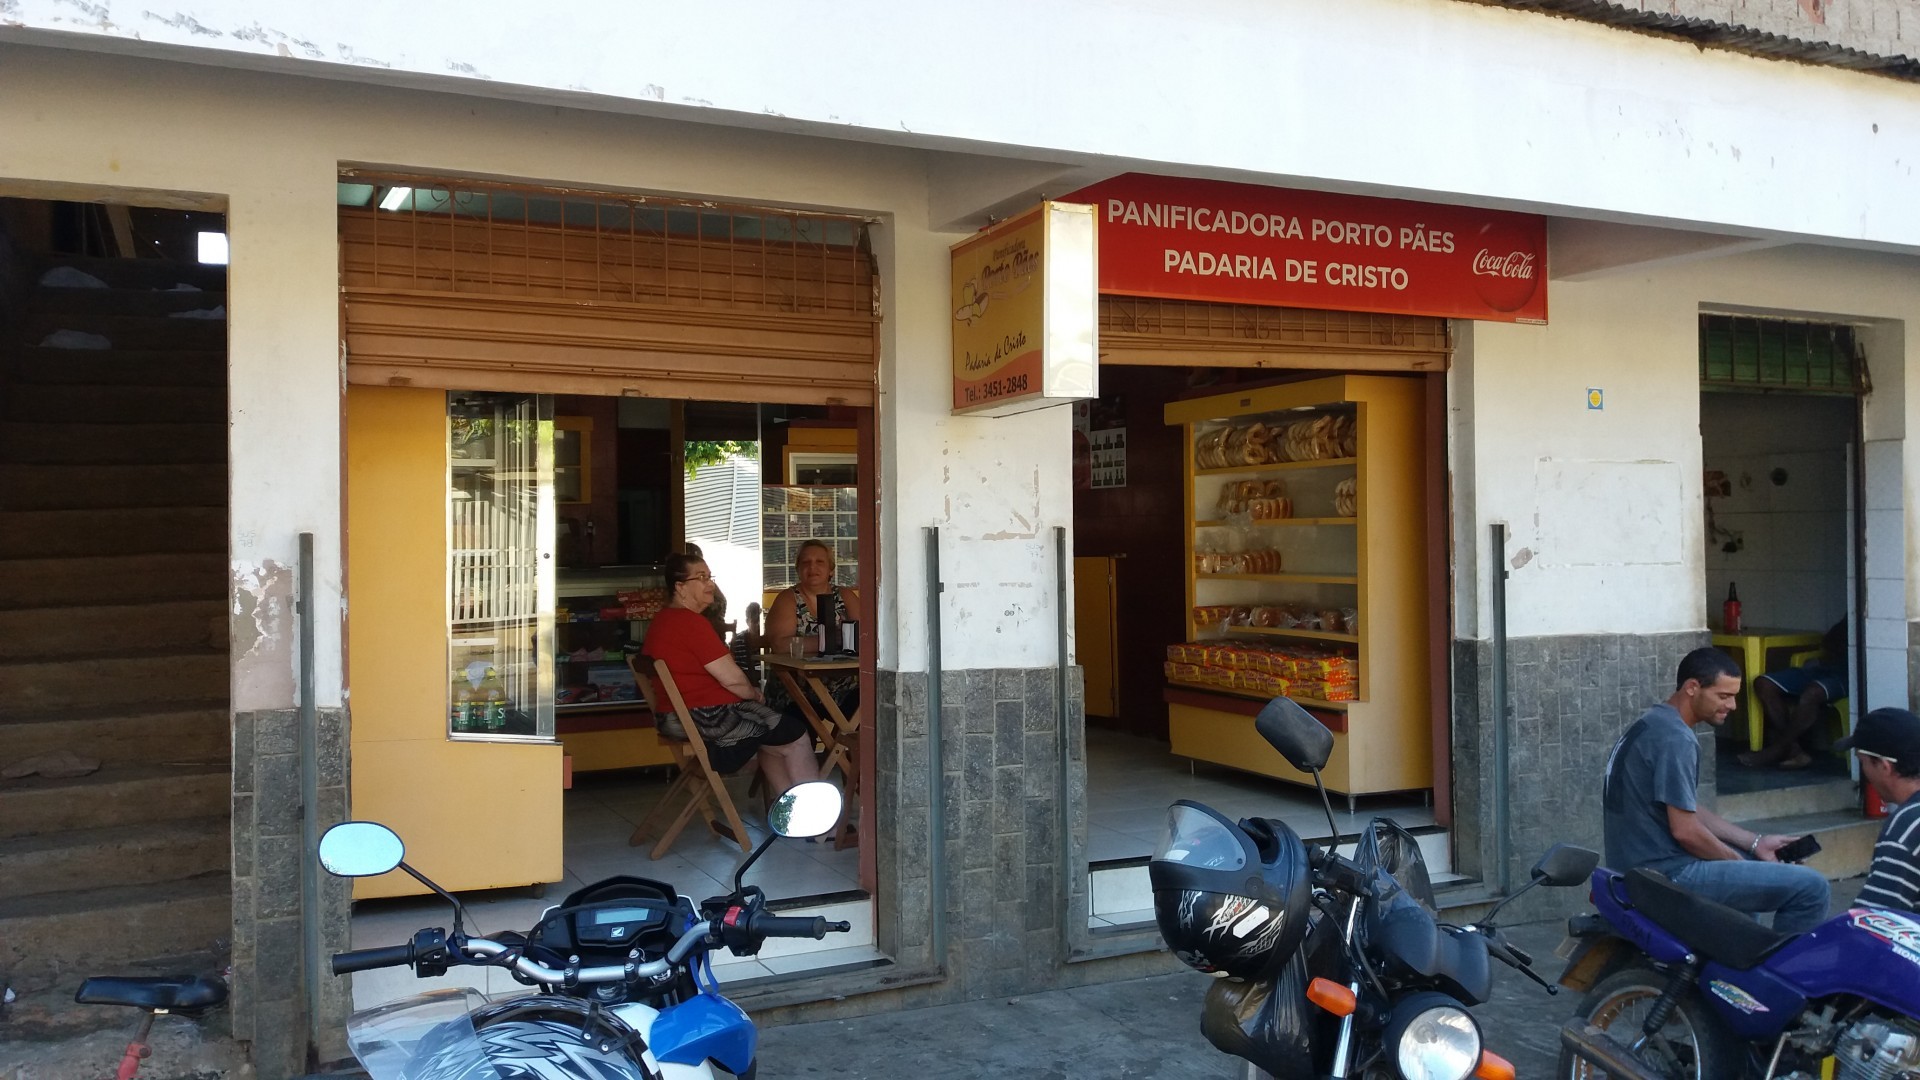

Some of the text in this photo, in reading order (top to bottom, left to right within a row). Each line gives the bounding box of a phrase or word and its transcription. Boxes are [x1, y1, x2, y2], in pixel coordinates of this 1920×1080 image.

[1108, 199, 1455, 254] PANIFICADORA PORTO PÃES
[1164, 249, 1409, 291] PADARIA DE CRISTO
[965, 330, 1027, 371] Padaria de Cristo
[964, 373, 1028, 402] Tel.: 3451-2848
